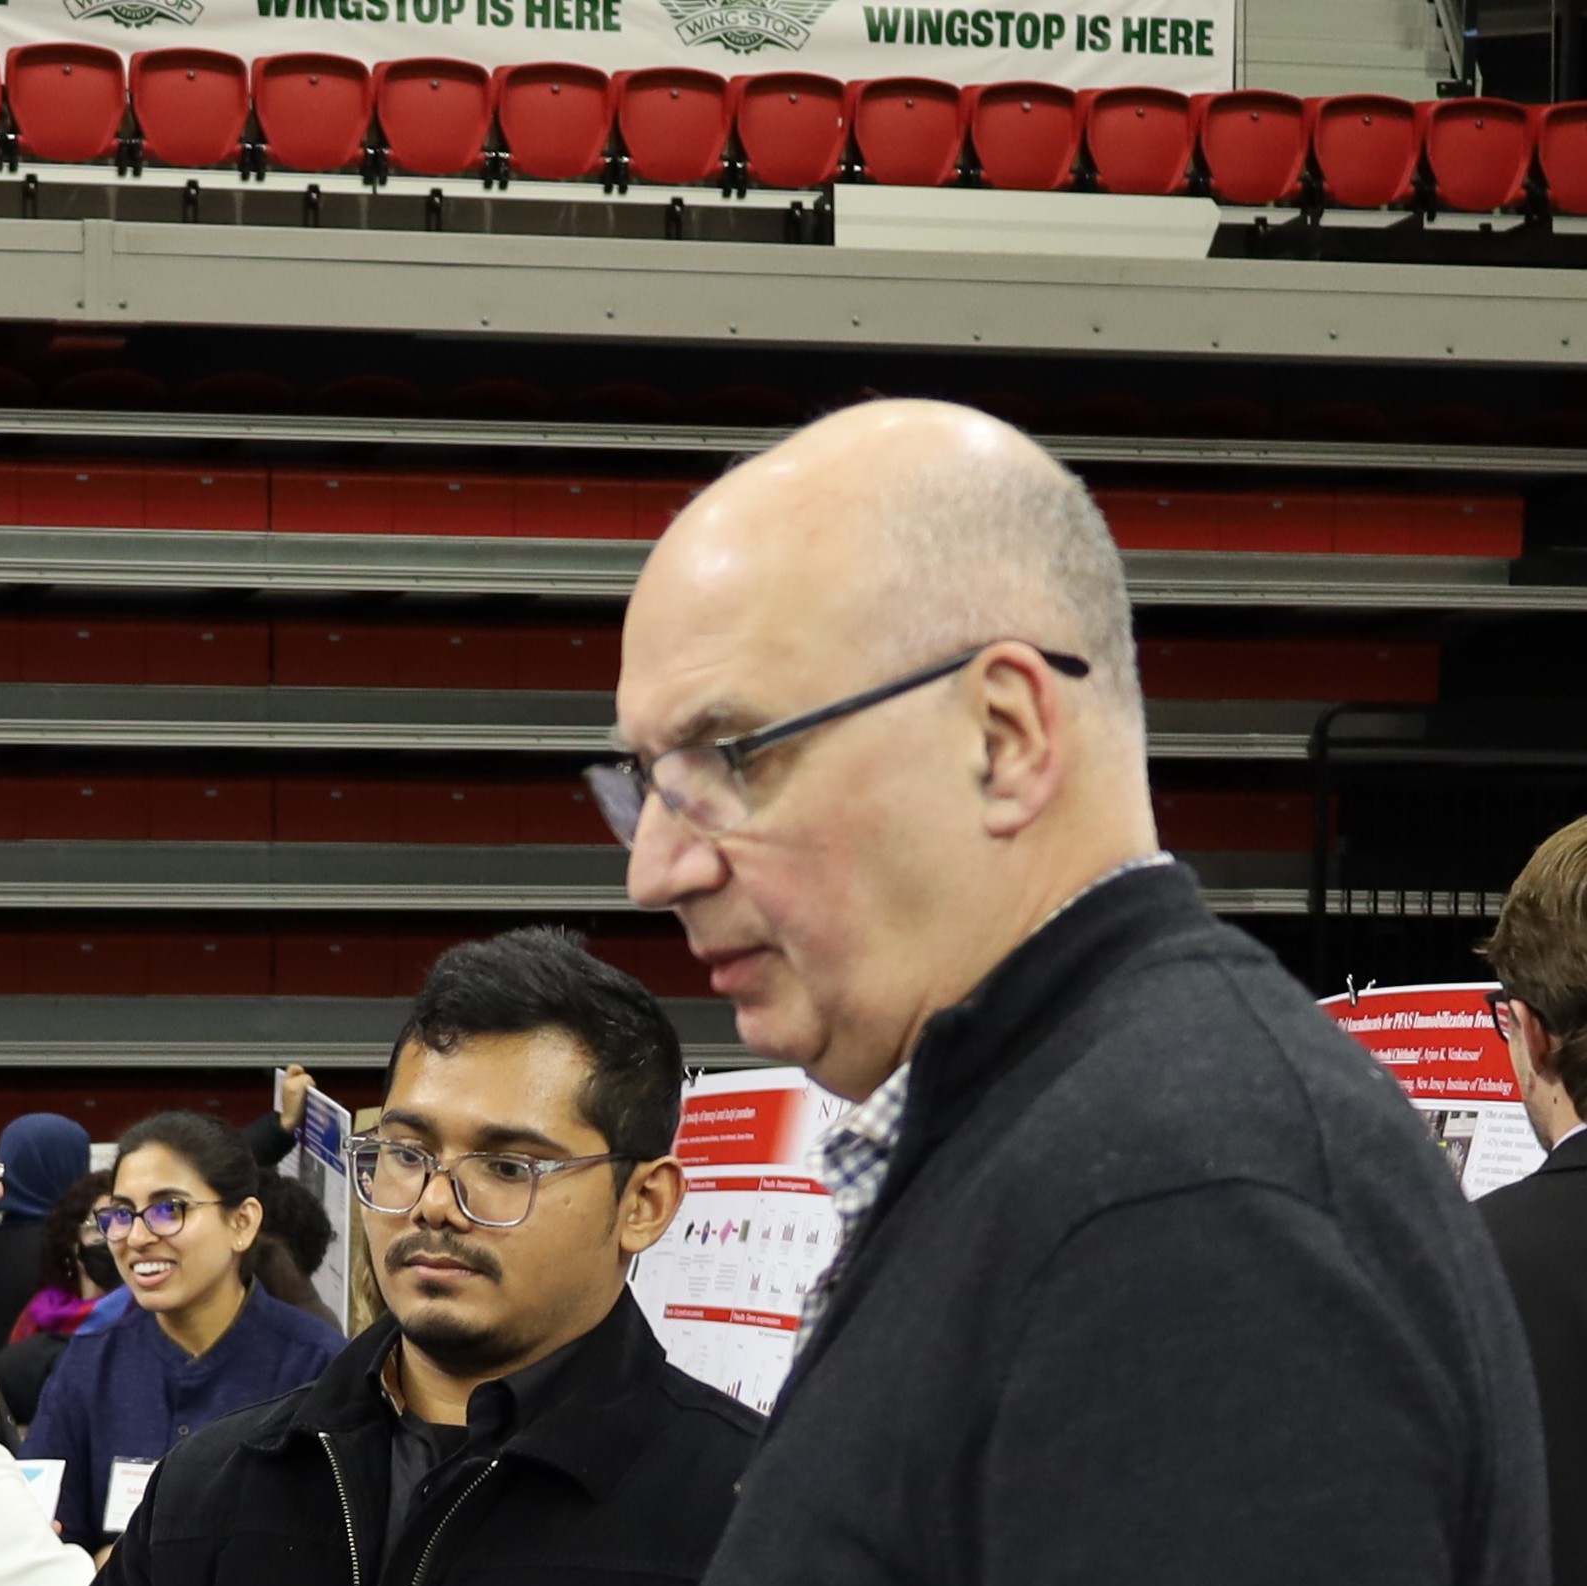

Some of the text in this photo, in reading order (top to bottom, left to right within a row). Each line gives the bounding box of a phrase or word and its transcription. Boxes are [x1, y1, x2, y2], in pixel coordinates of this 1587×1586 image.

[476, 0, 514, 28] IS
[525, 0, 623, 32] HERE
[863, 6, 1215, 57] WINGSTOP IS HERE
[1392, 1011, 1414, 1029] PFAS
